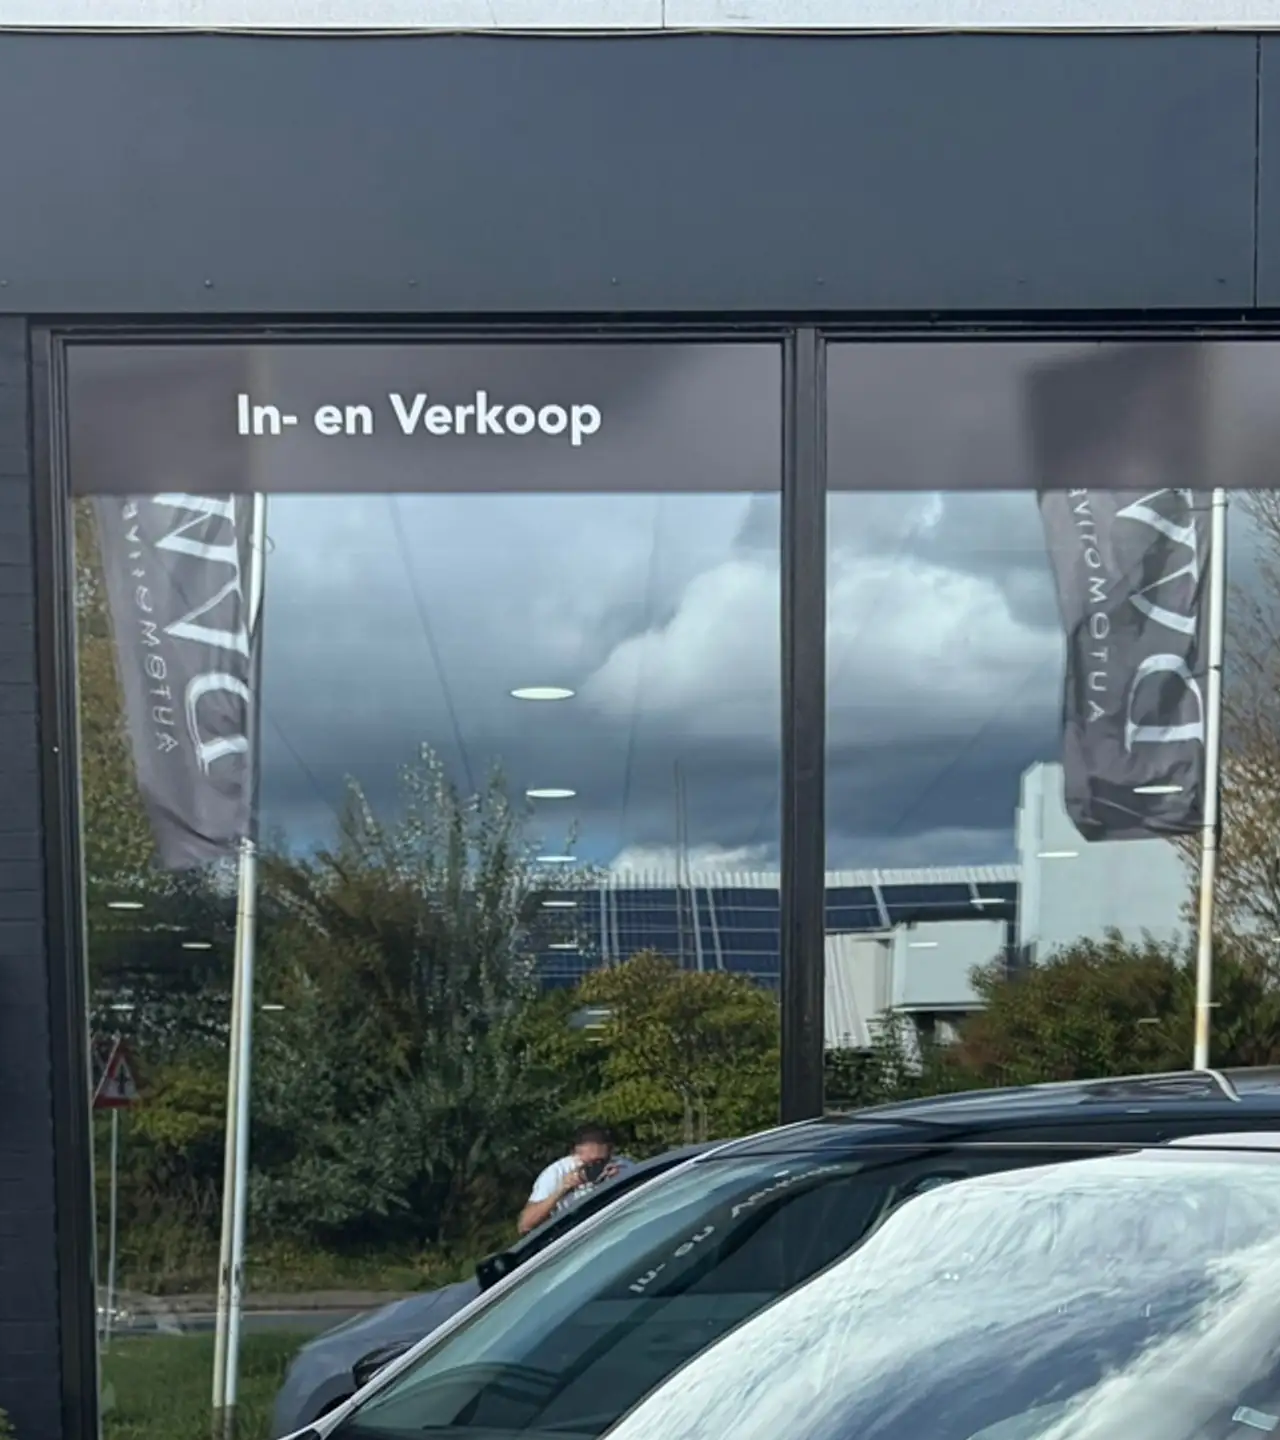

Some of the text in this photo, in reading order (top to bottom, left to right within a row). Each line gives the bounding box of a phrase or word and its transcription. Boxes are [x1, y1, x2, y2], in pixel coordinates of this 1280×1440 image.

[237, 390, 602, 446] In- en Verkoop
